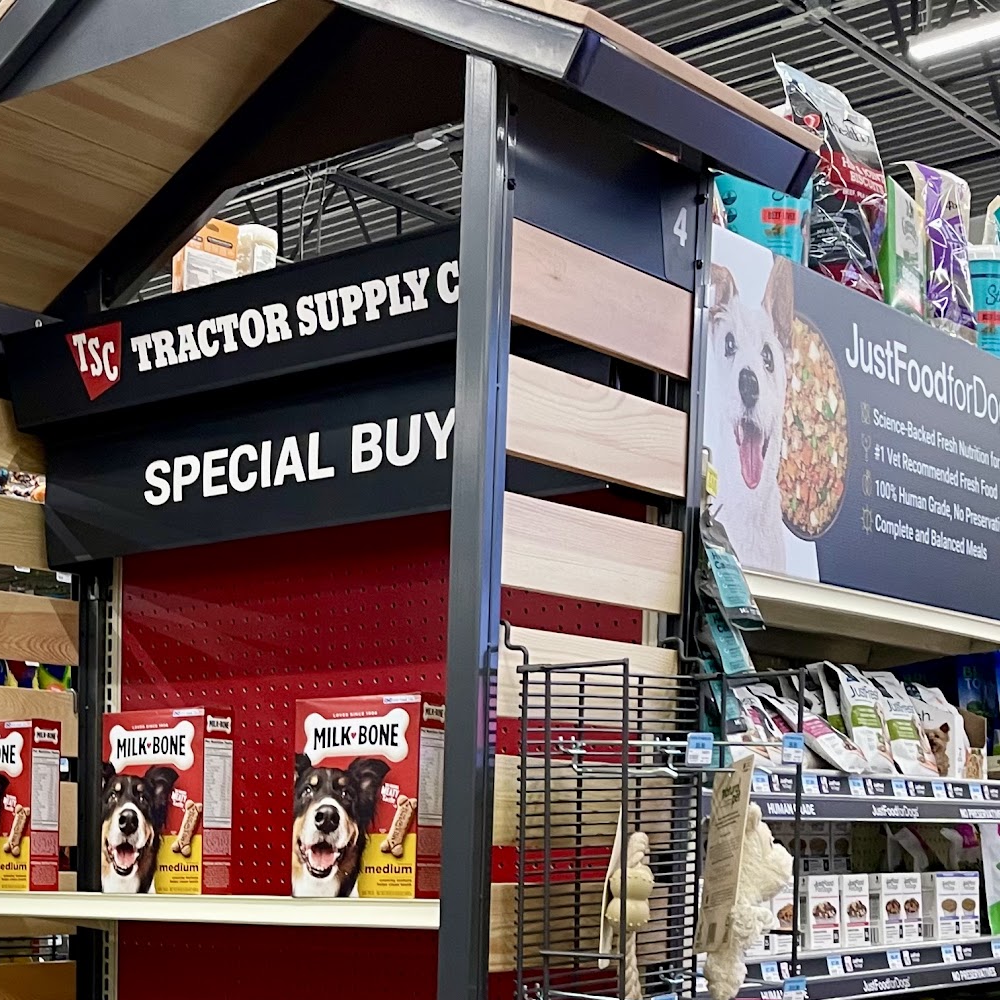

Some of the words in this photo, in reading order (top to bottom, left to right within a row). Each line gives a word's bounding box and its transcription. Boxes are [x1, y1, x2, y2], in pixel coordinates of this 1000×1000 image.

[673, 207, 687, 247] 4
[72, 333, 119, 383] TSC
[130, 303, 292, 373] TRACTOR
[295, 267, 430, 337] SUPPLY
[437, 260, 459, 304] C
[845, 322, 1000, 425] JustFoodforDo
[143, 430, 334, 507] SPECIAL
[351, 407, 456, 474] BUY
[873, 408, 936, 446] Science-Backed
[937, 431, 958, 455] Fresh
[959, 439, 989, 466] Nutrition
[874, 443, 885, 463] #1
[887, 447, 901, 469] Vet
[902, 452, 958, 487] Recommended
[959, 472, 980, 495] Fresh
[981, 478, 998, 500] Food
[875, 479, 897, 502] 100%
[898, 486, 927, 511] Human
[928, 495, 952, 521] Grade,
[953, 503, 964, 522] No
[965, 506, 1000, 533] Preservati
[875, 513, 914, 541] Complete
[914, 527, 930, 545] and
[930, 529, 965, 555] Balanced
[965, 538, 987, 560] Meals
[117, 737, 147, 759] MILK
[152, 735, 186, 756] BONE
[313, 725, 352, 751] MILK
[358, 723, 399, 747] BONE
[766, 802, 795, 815] HUMAN
[794, 803, 816, 816] ADE
[159, 863, 199, 873] medium
[365, 863, 413, 874] medium
